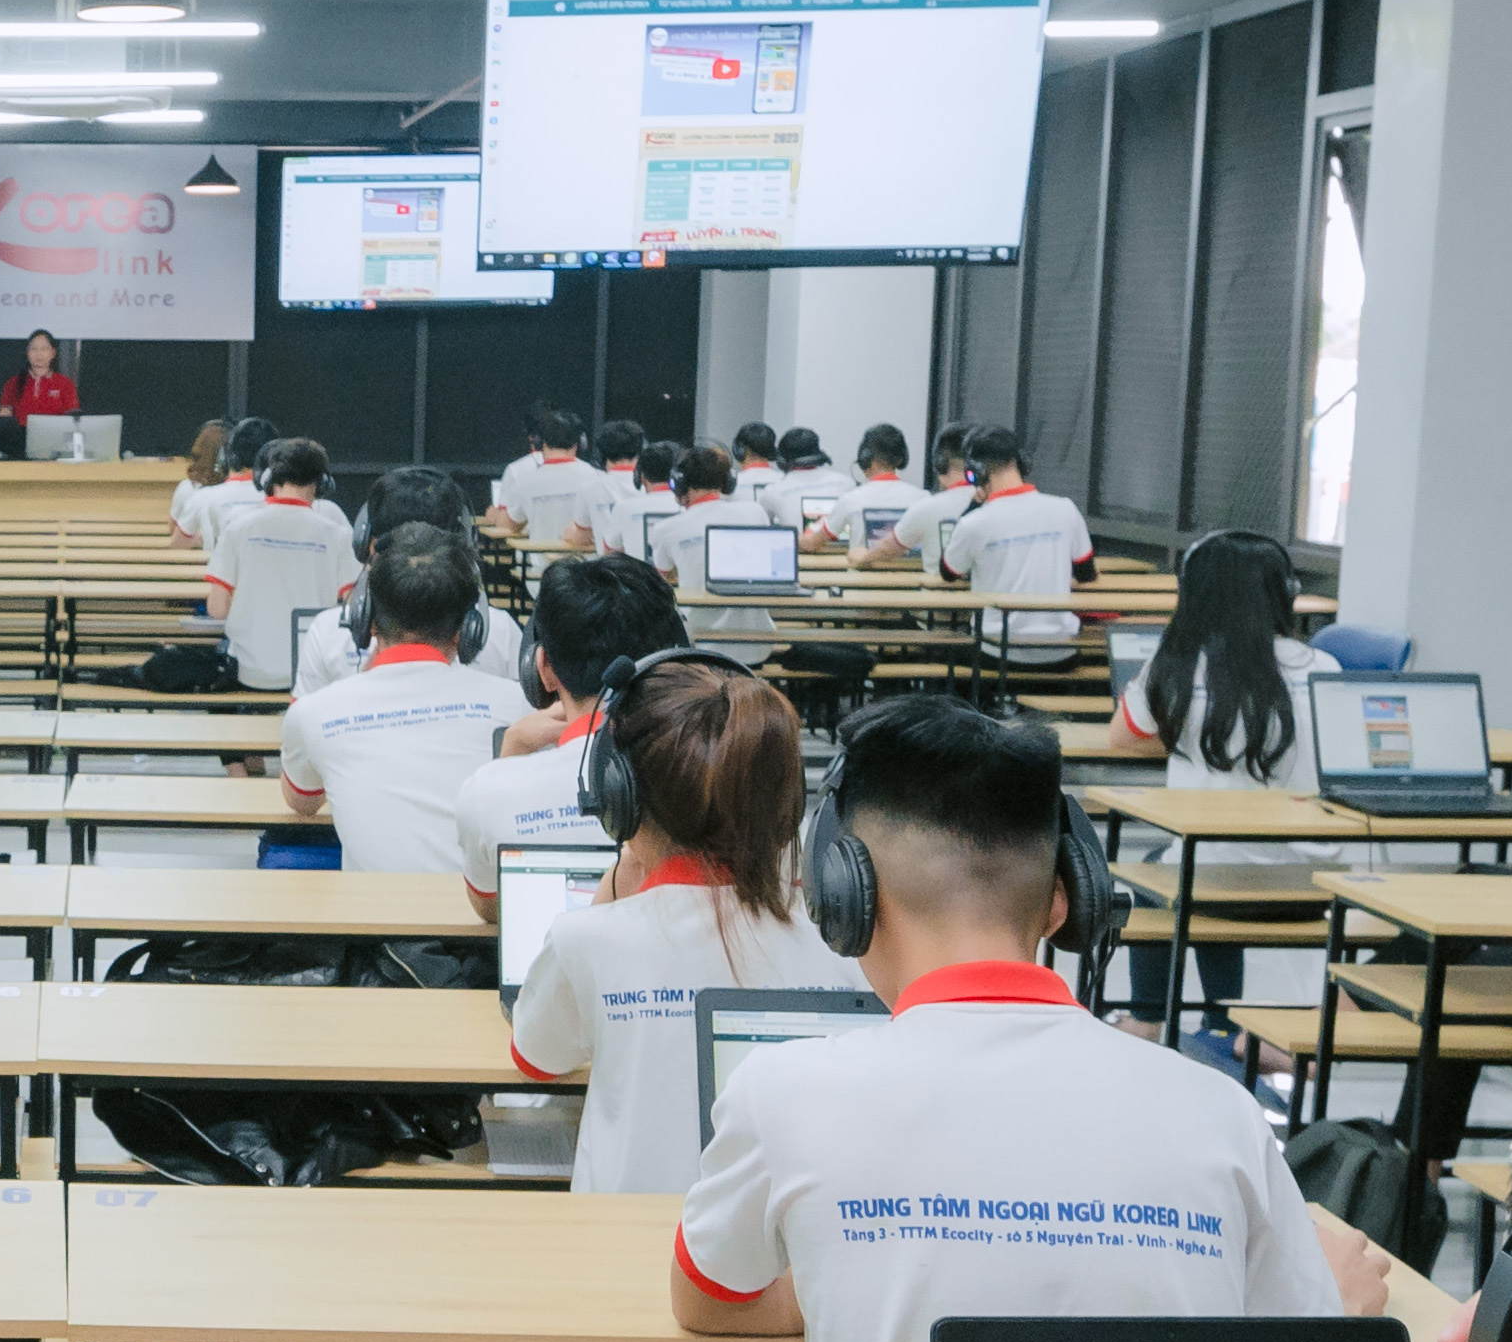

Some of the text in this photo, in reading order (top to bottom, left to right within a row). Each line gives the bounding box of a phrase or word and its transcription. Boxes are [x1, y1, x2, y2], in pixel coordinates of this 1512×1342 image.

[103, 249, 174, 275] link
[55, 289, 97, 307] and
[111, 288, 175, 307] More
[514, 808, 554, 825] TRUNG
[59, 986, 107, 997] 07
[602, 986, 684, 1007] TRUNG TÂM
[94, 1189, 159, 1208] 07
[837, 1197, 912, 1220] TRUNG
[919, 1193, 971, 1219] TÂM
[1113, 1204, 1179, 1229] KOREA
[1187, 1211, 1223, 1237] LINK
[899, 1226, 938, 1239] TTTM
[942, 1227, 993, 1244] Ecocity
[1136, 1234, 1167, 1249] Vinh
[1208, 1244, 1223, 1259] An
